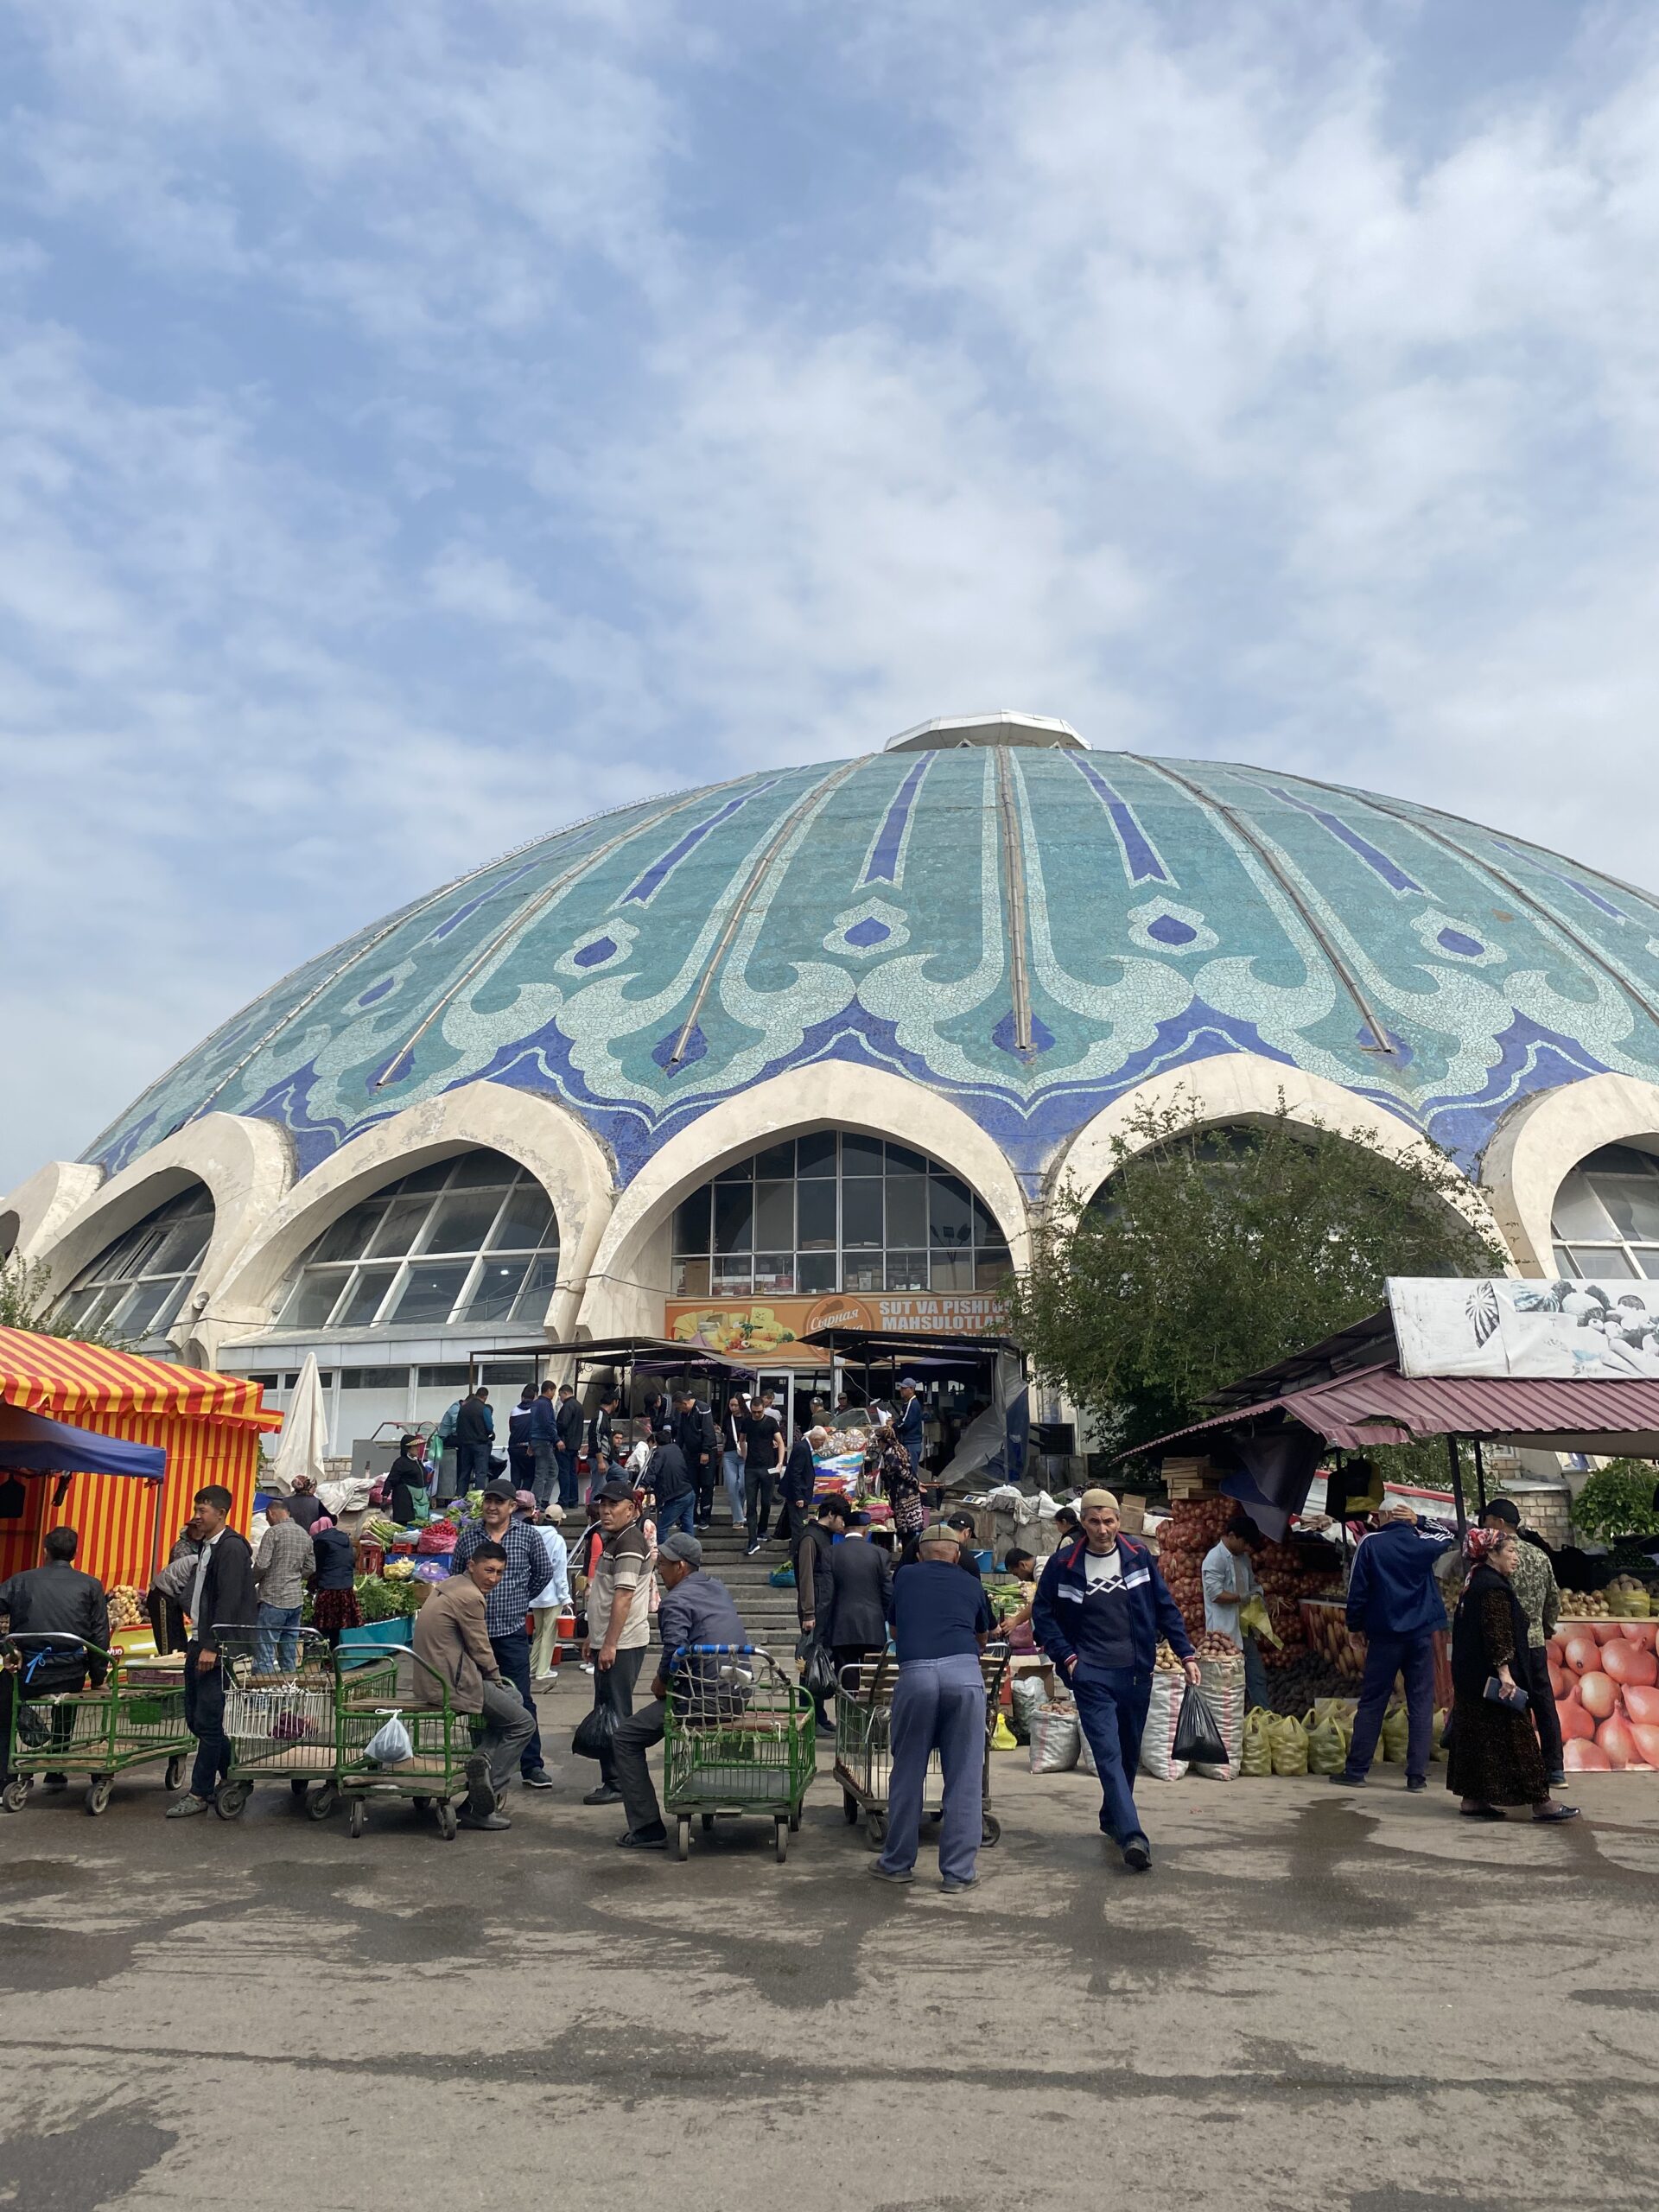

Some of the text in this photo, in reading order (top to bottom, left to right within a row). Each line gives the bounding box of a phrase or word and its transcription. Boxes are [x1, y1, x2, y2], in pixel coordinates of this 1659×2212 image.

[880, 1300, 912, 1315] SUT
[916, 1300, 938, 1314] VA
[810, 1308, 859, 1331] Сырная
